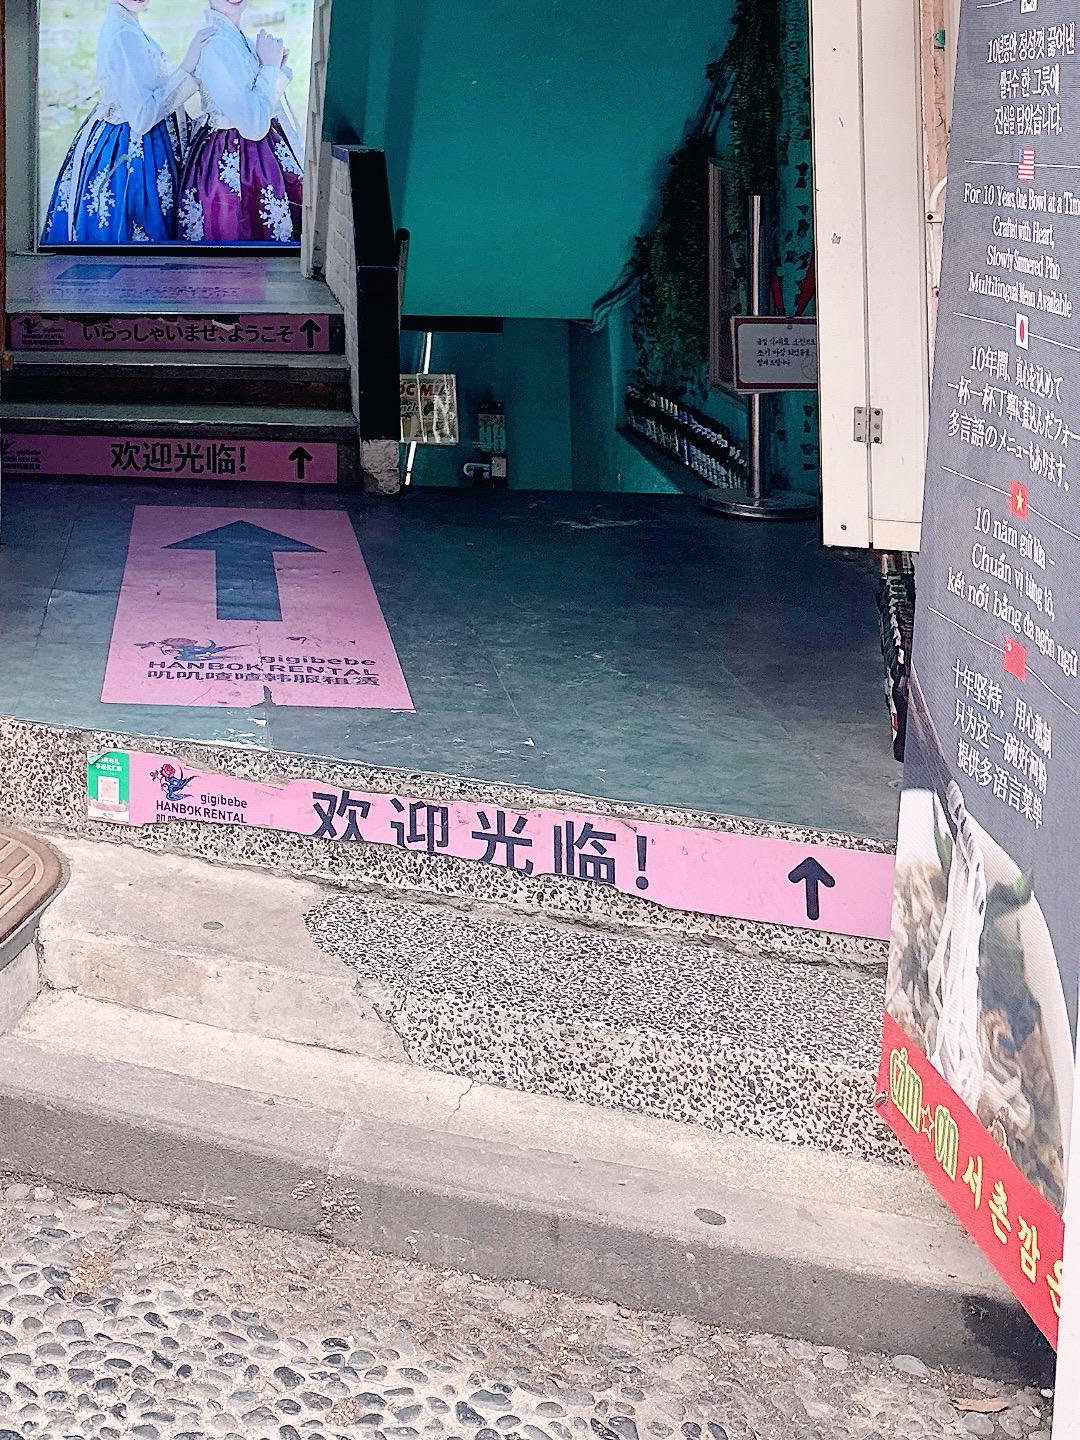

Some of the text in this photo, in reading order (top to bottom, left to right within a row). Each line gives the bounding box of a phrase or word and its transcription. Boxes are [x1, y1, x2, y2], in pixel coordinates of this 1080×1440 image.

[1021, 66, 1031, 97] 한
[1016, 102, 1063, 136] 담았습니다.
[964, 182, 981, 204] For
[982, 184, 995, 205] 10
[1028, 188, 1047, 212] Bowl
[1047, 191, 1057, 213] at
[1057, 197, 1063, 214] a
[1032, 221, 1055, 250] Heart,
[986, 244, 1014, 272] Slowly
[1044, 255, 1061, 281] Pho
[968, 271, 1019, 303] Multilingual
[1036, 287, 1072, 319] Available
[83, 323, 294, 344] いらっしゃいませ、ようこそ
[110, 442, 248, 474] 欢迎光临!
[974, 506, 991, 534] 10
[993, 518, 1018, 549] năm
[947, 566, 966, 599] kết
[149, 661, 379, 676] HANBOK RENTAL
[156, 799, 202, 817] HANBOK
[203, 807, 248, 824] RENTAL
[200, 792, 248, 809] gigibebe
